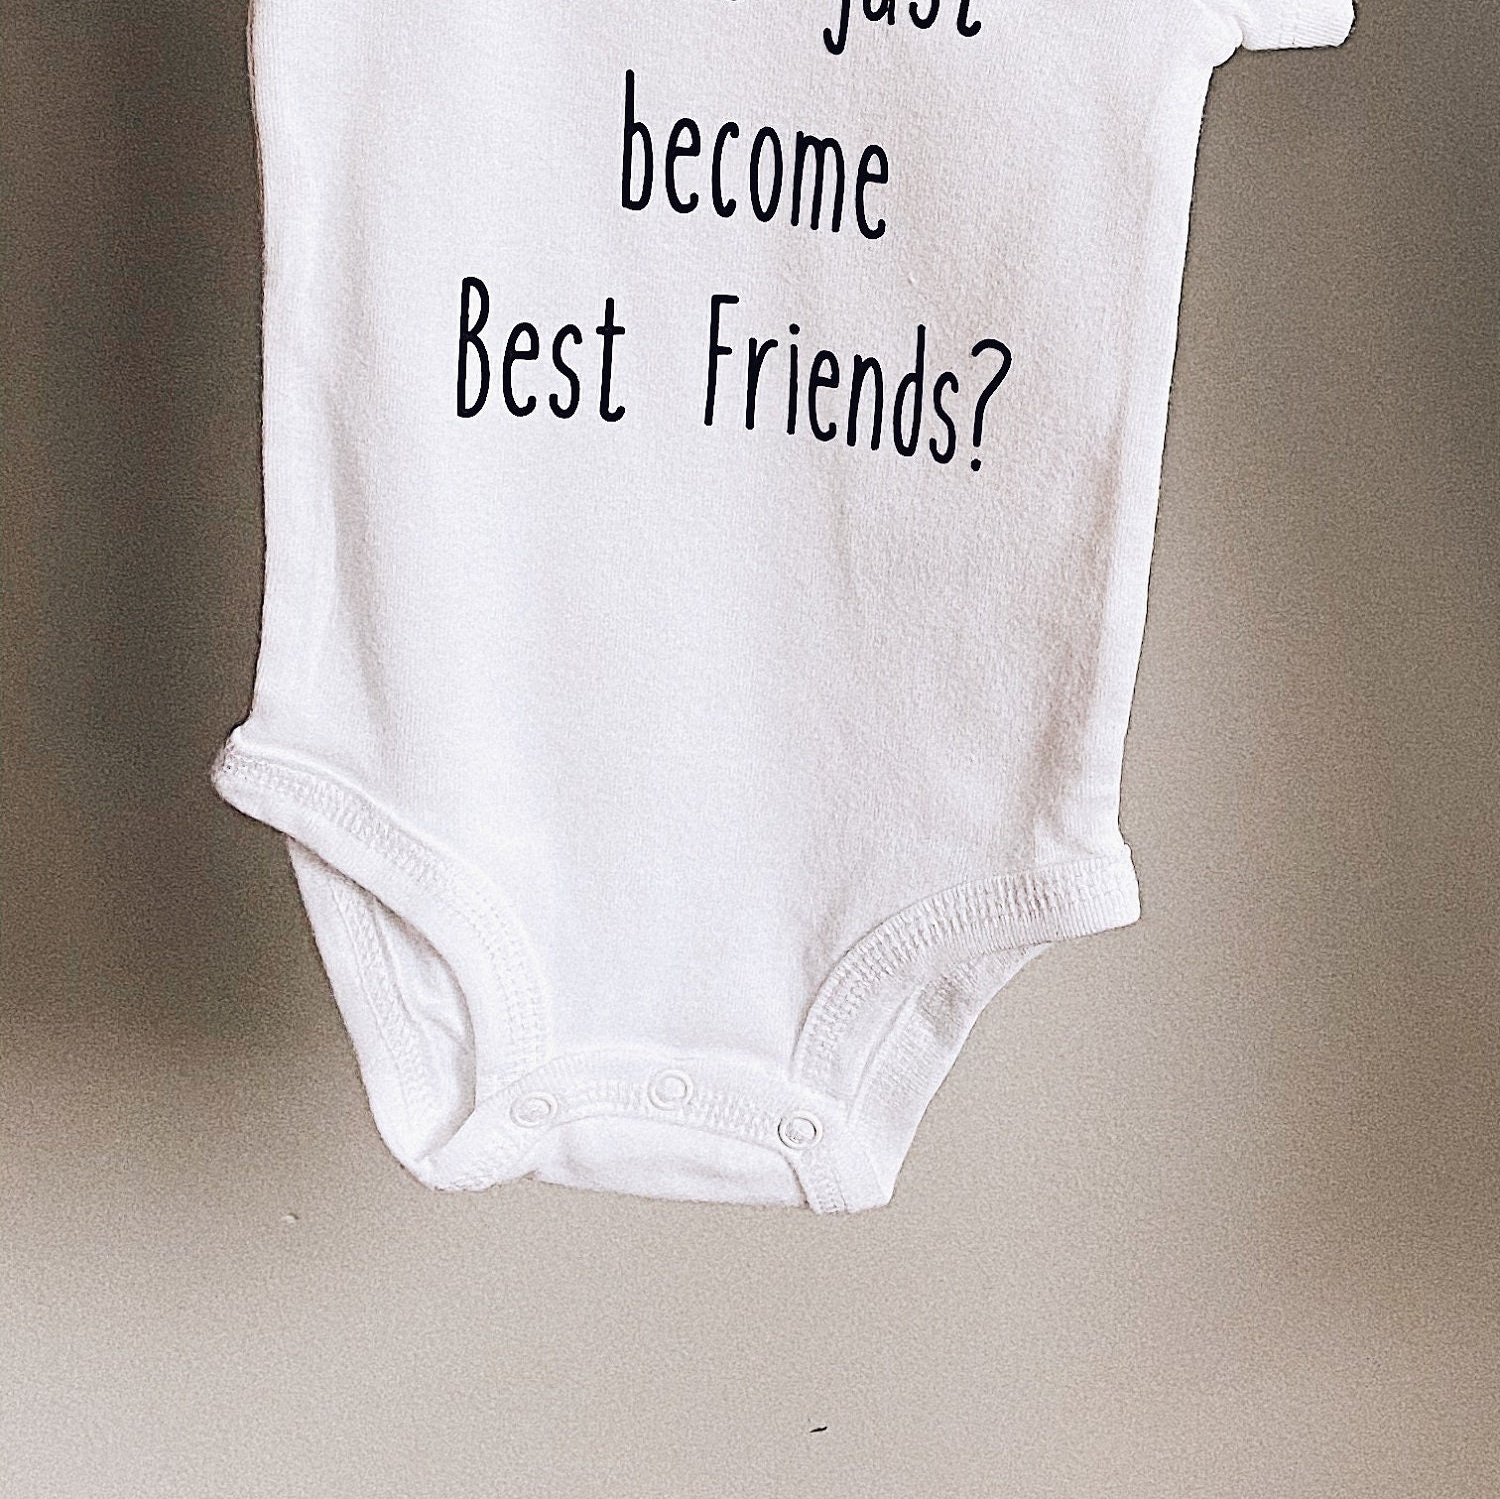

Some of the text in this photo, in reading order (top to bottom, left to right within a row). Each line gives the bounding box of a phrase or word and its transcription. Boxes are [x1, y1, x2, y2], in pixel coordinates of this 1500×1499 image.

[621, 68, 889, 240] become
[456, 276, 1013, 473] Best Friends?
